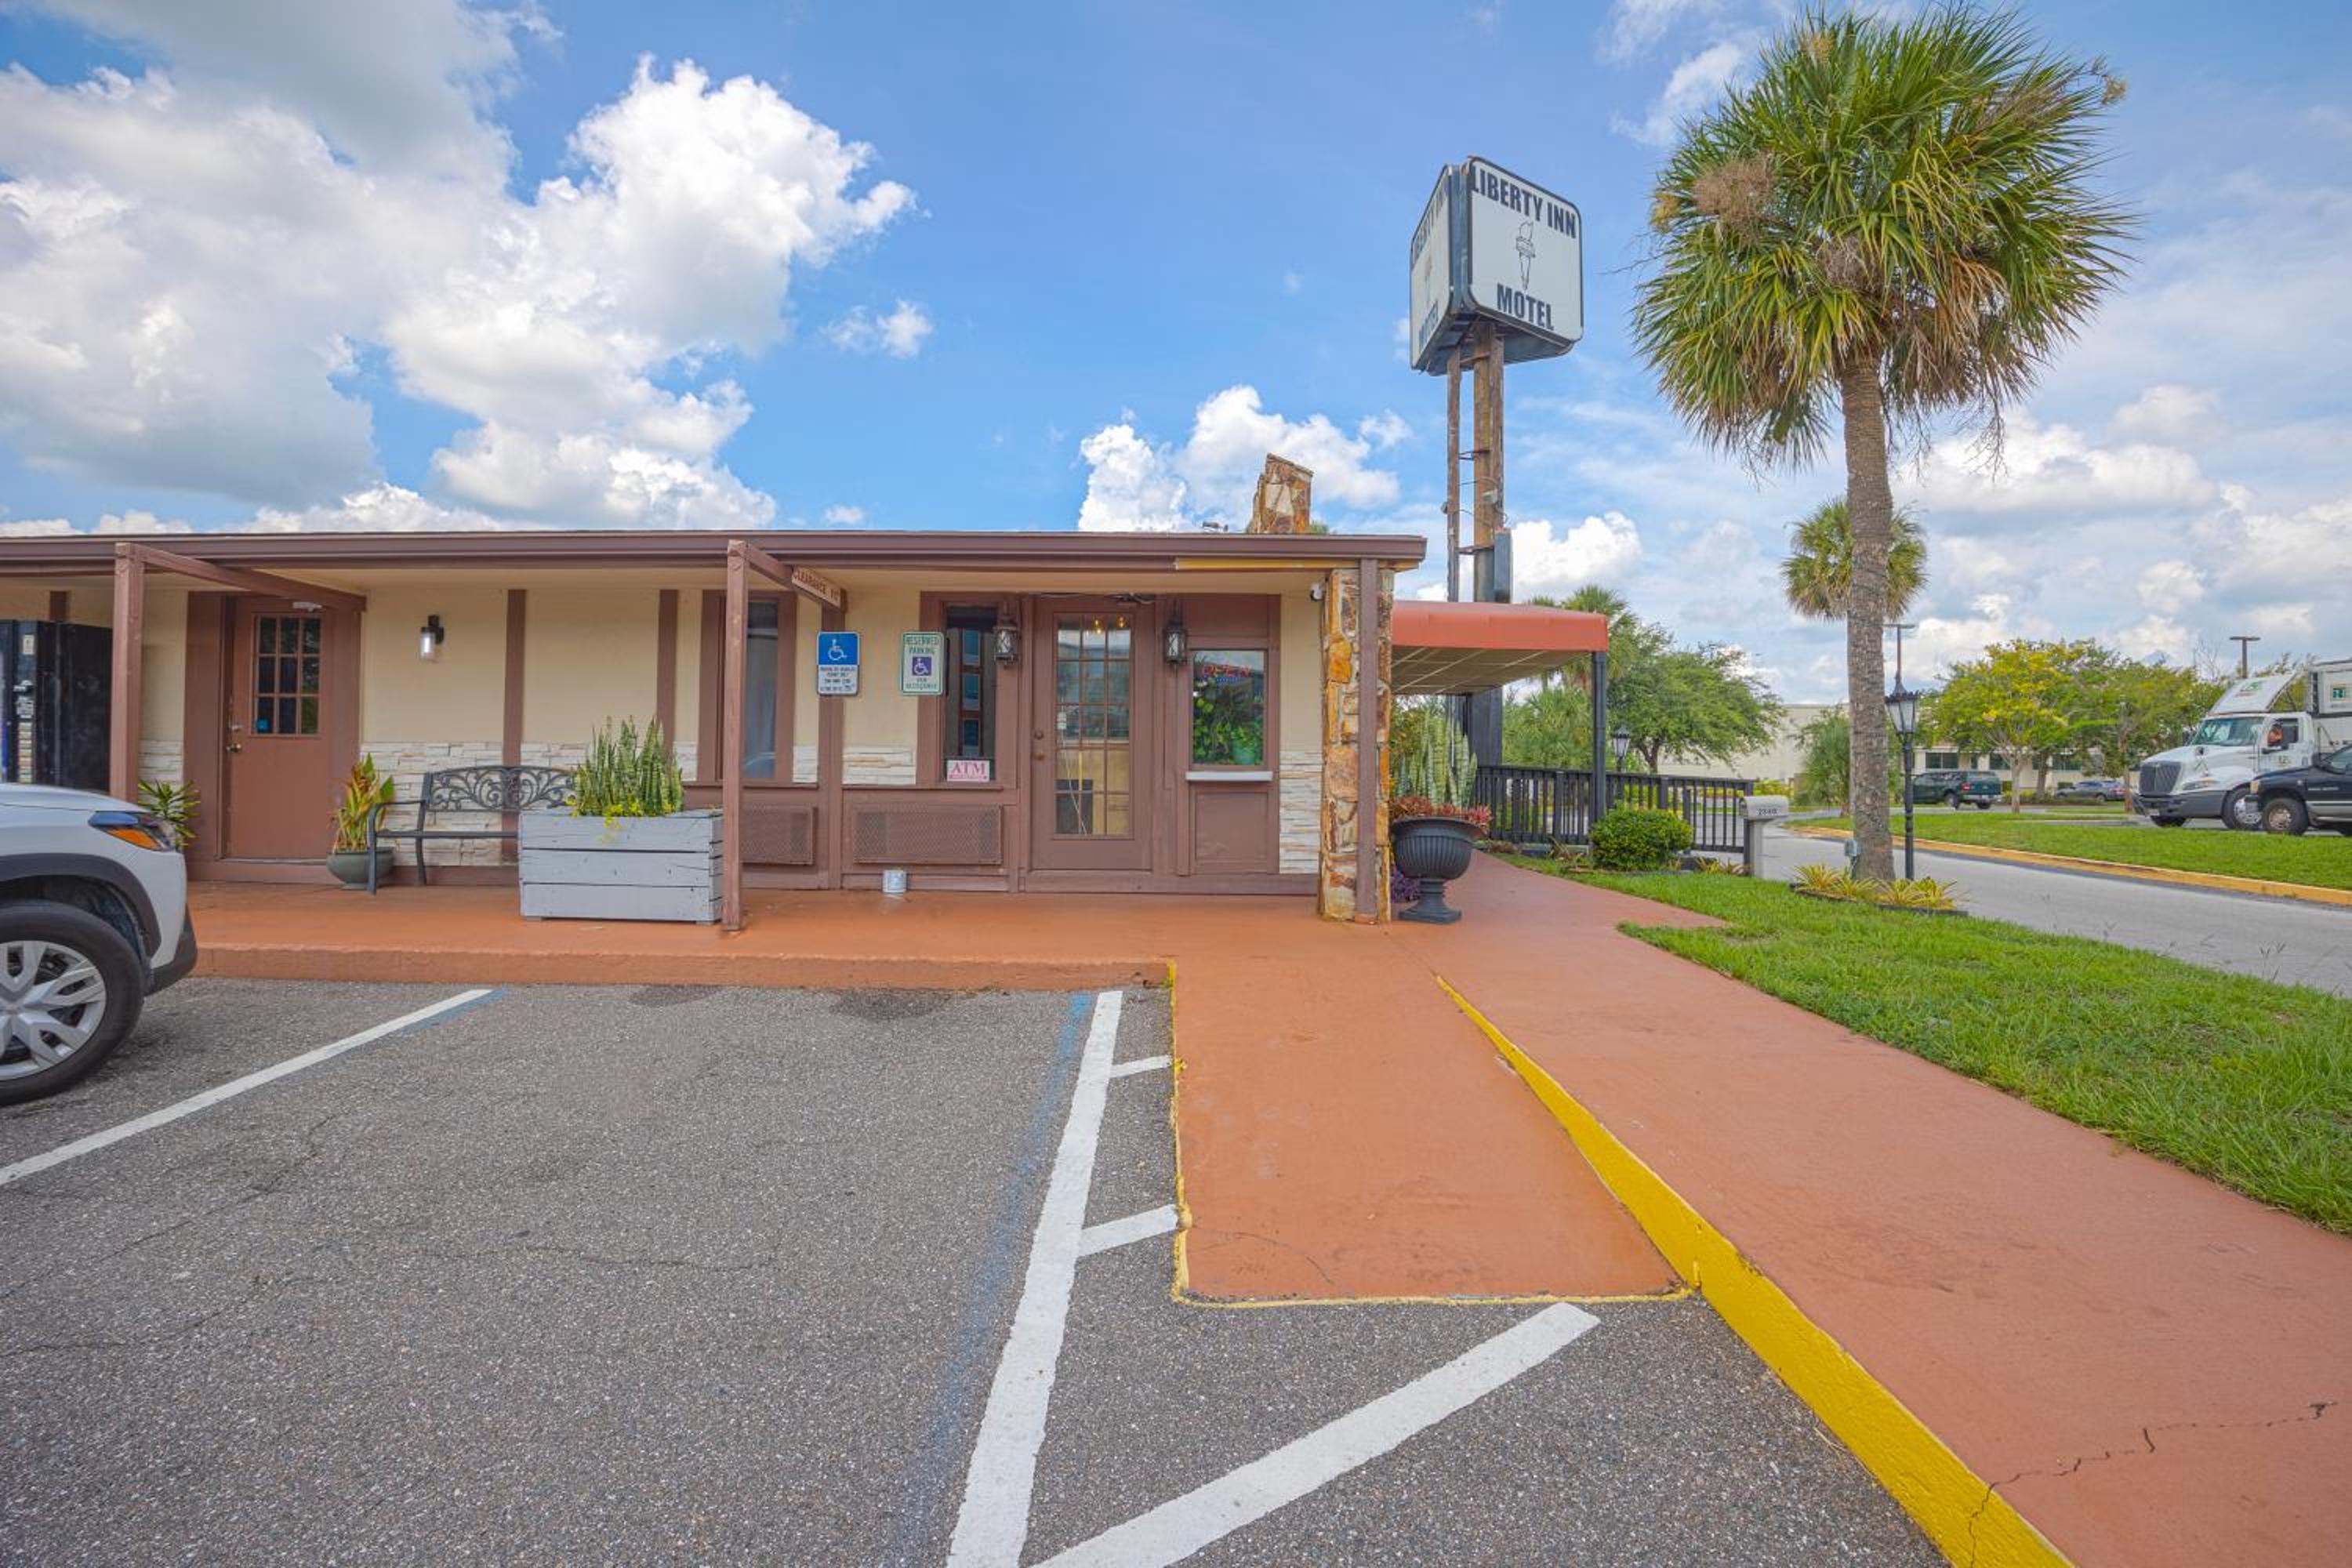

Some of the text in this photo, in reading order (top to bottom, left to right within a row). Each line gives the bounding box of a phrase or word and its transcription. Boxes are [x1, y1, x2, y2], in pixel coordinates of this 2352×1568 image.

[1472, 165, 1543, 221] LIBERTY
[1547, 201, 1577, 238] INN
[1497, 283, 1555, 330] MOTEL
[950, 762, 986, 775] ATM
